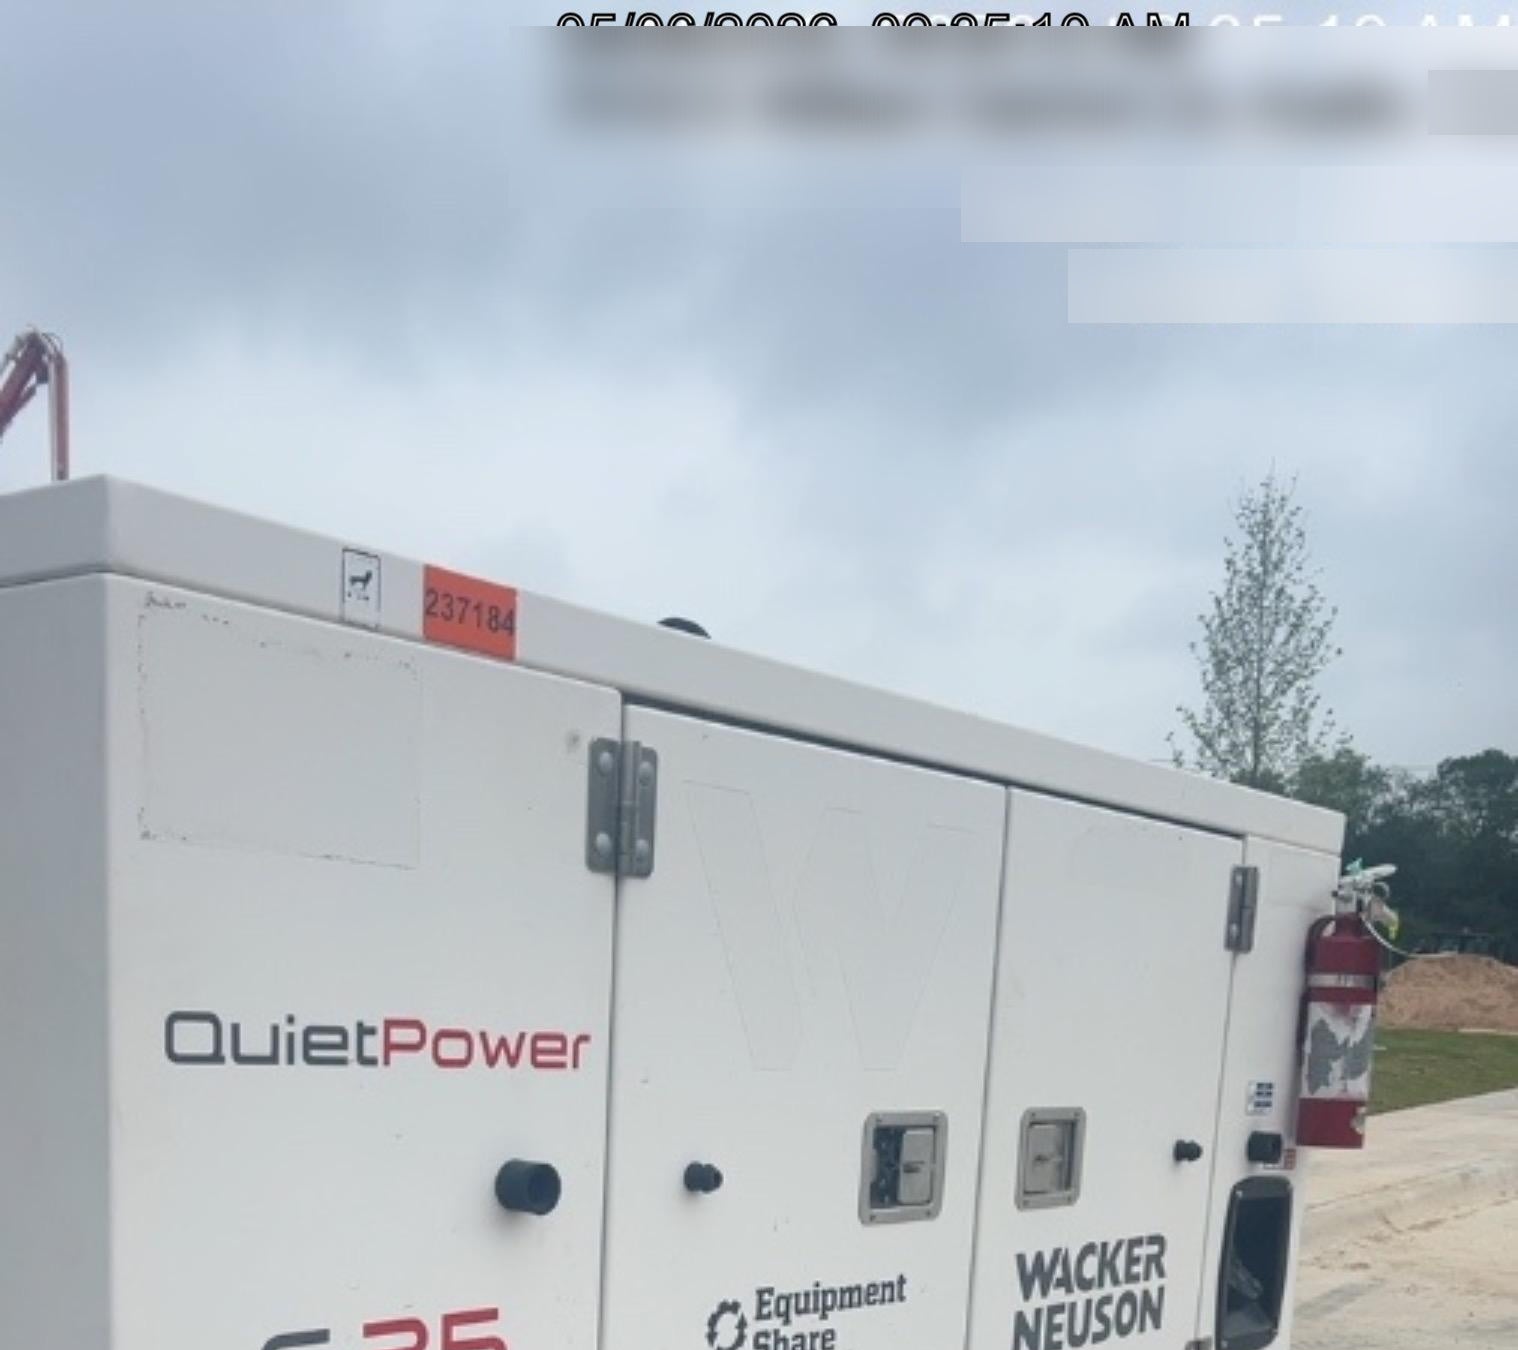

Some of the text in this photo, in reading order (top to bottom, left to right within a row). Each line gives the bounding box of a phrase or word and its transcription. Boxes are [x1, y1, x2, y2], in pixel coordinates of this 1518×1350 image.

[425, 588, 515, 637] 237184
[165, 1010, 591, 1070] QuietPower
[1016, 1234, 1167, 1302] WACKER
[755, 1273, 907, 1325] Equipment
